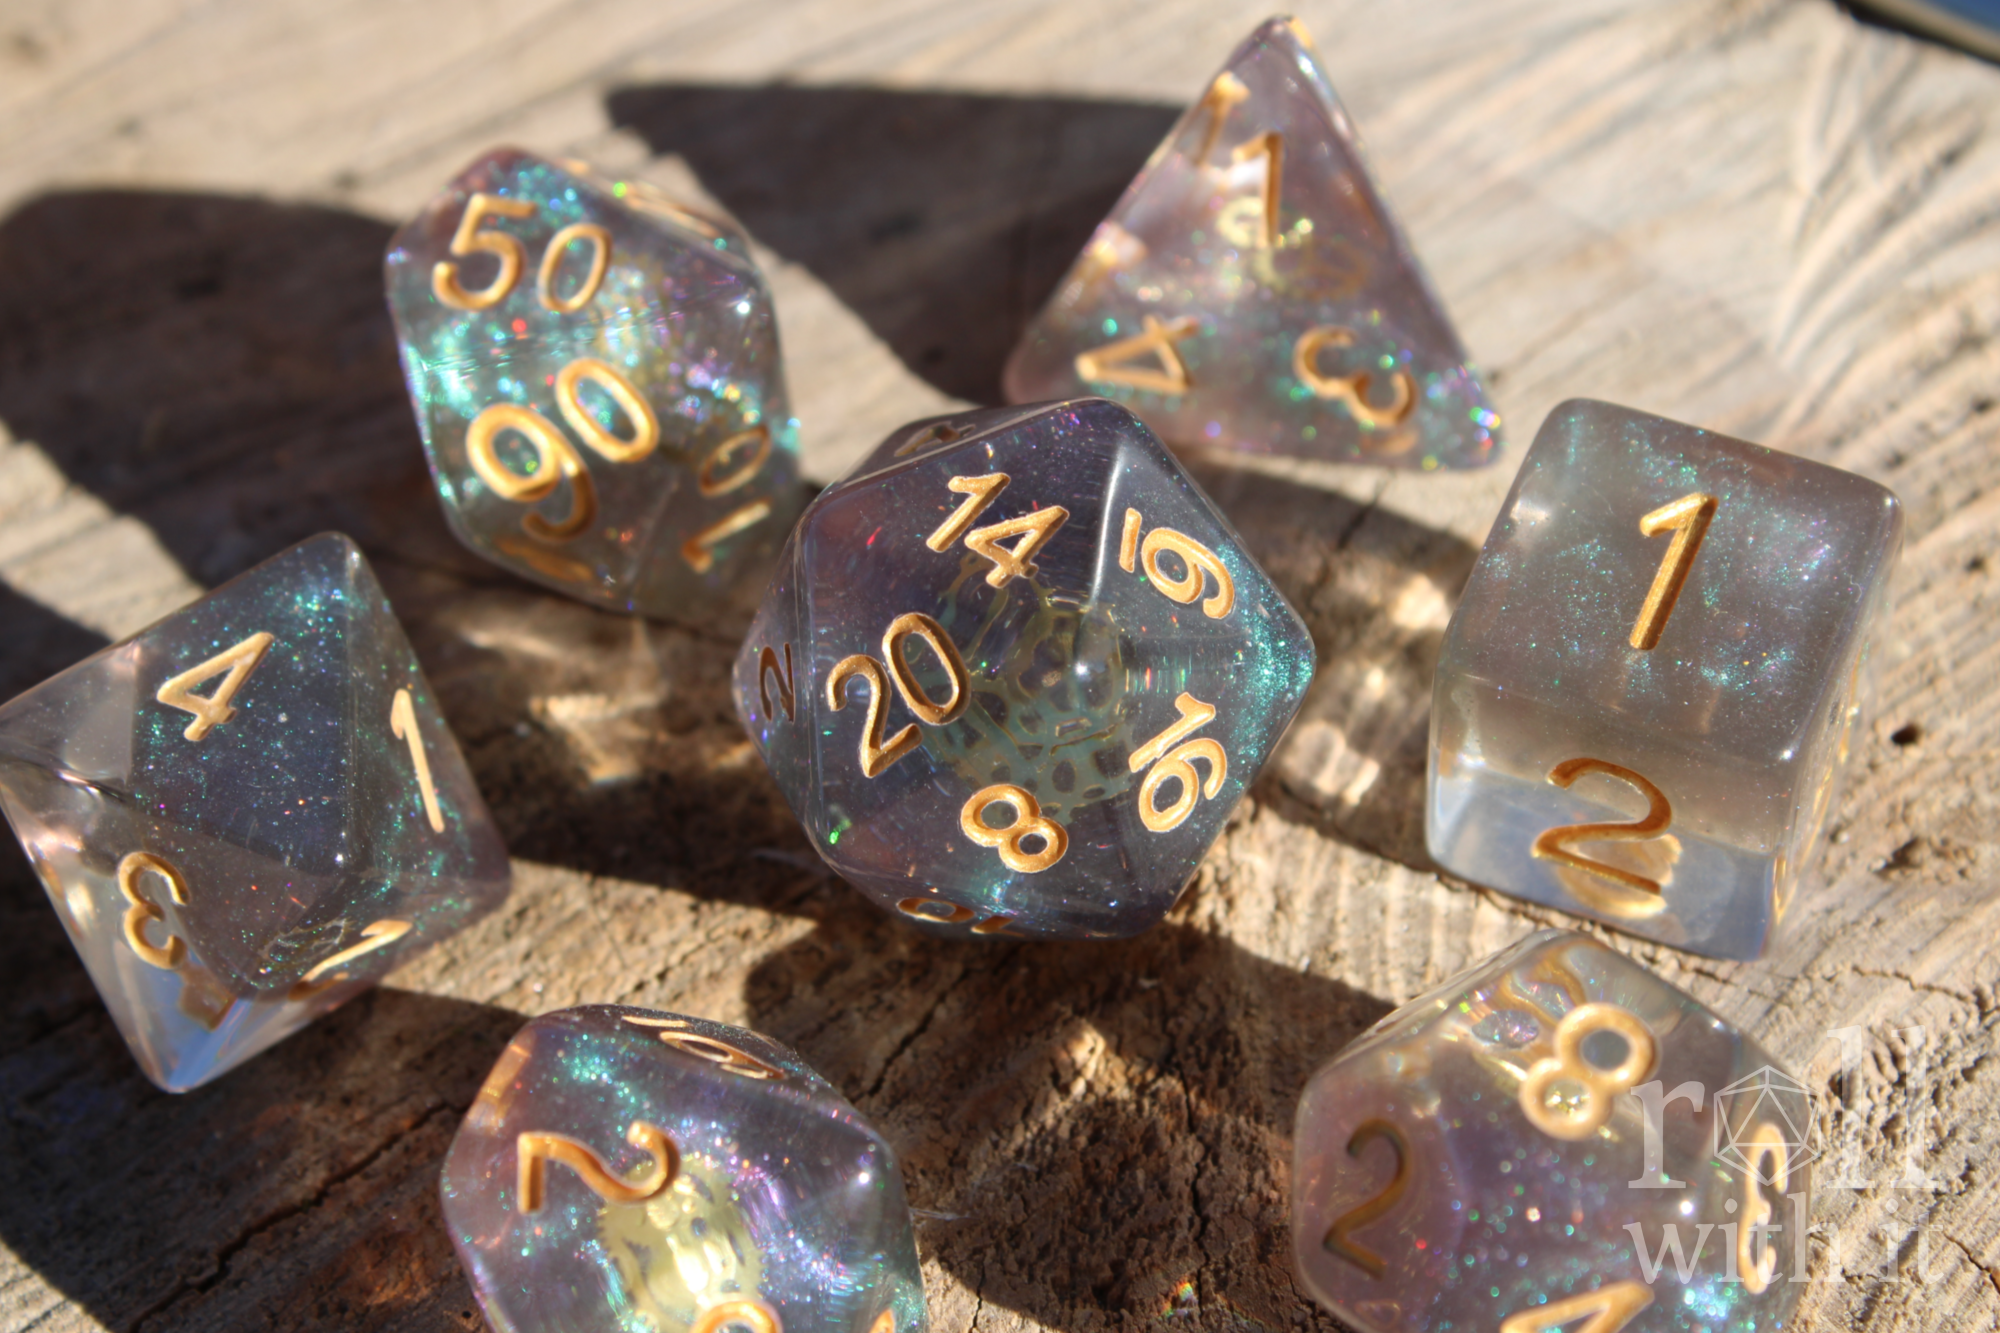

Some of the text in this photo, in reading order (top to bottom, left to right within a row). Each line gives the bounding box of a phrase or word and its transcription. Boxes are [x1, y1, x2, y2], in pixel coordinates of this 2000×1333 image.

[1231, 131, 1282, 247] 1
[432, 192, 613, 314] 50
[1075, 315, 1197, 393] 4
[1293, 326, 1418, 428] 3
[466, 357, 661, 543] 90
[926, 473, 1070, 589] 14
[1629, 492, 1720, 652] 1
[155, 632, 275, 742] 4
[826, 612, 972, 779] 20
[390, 688, 446, 834] 1
[1128, 691, 1227, 833] 16
[960, 783, 1069, 874] 8
[1531, 757, 1672, 896] 2
[117, 851, 190, 970] 3
[1520, 1002, 1660, 1142] 8
[517, 1120, 681, 1216] 2
[1323, 1117, 1411, 1281] 2
